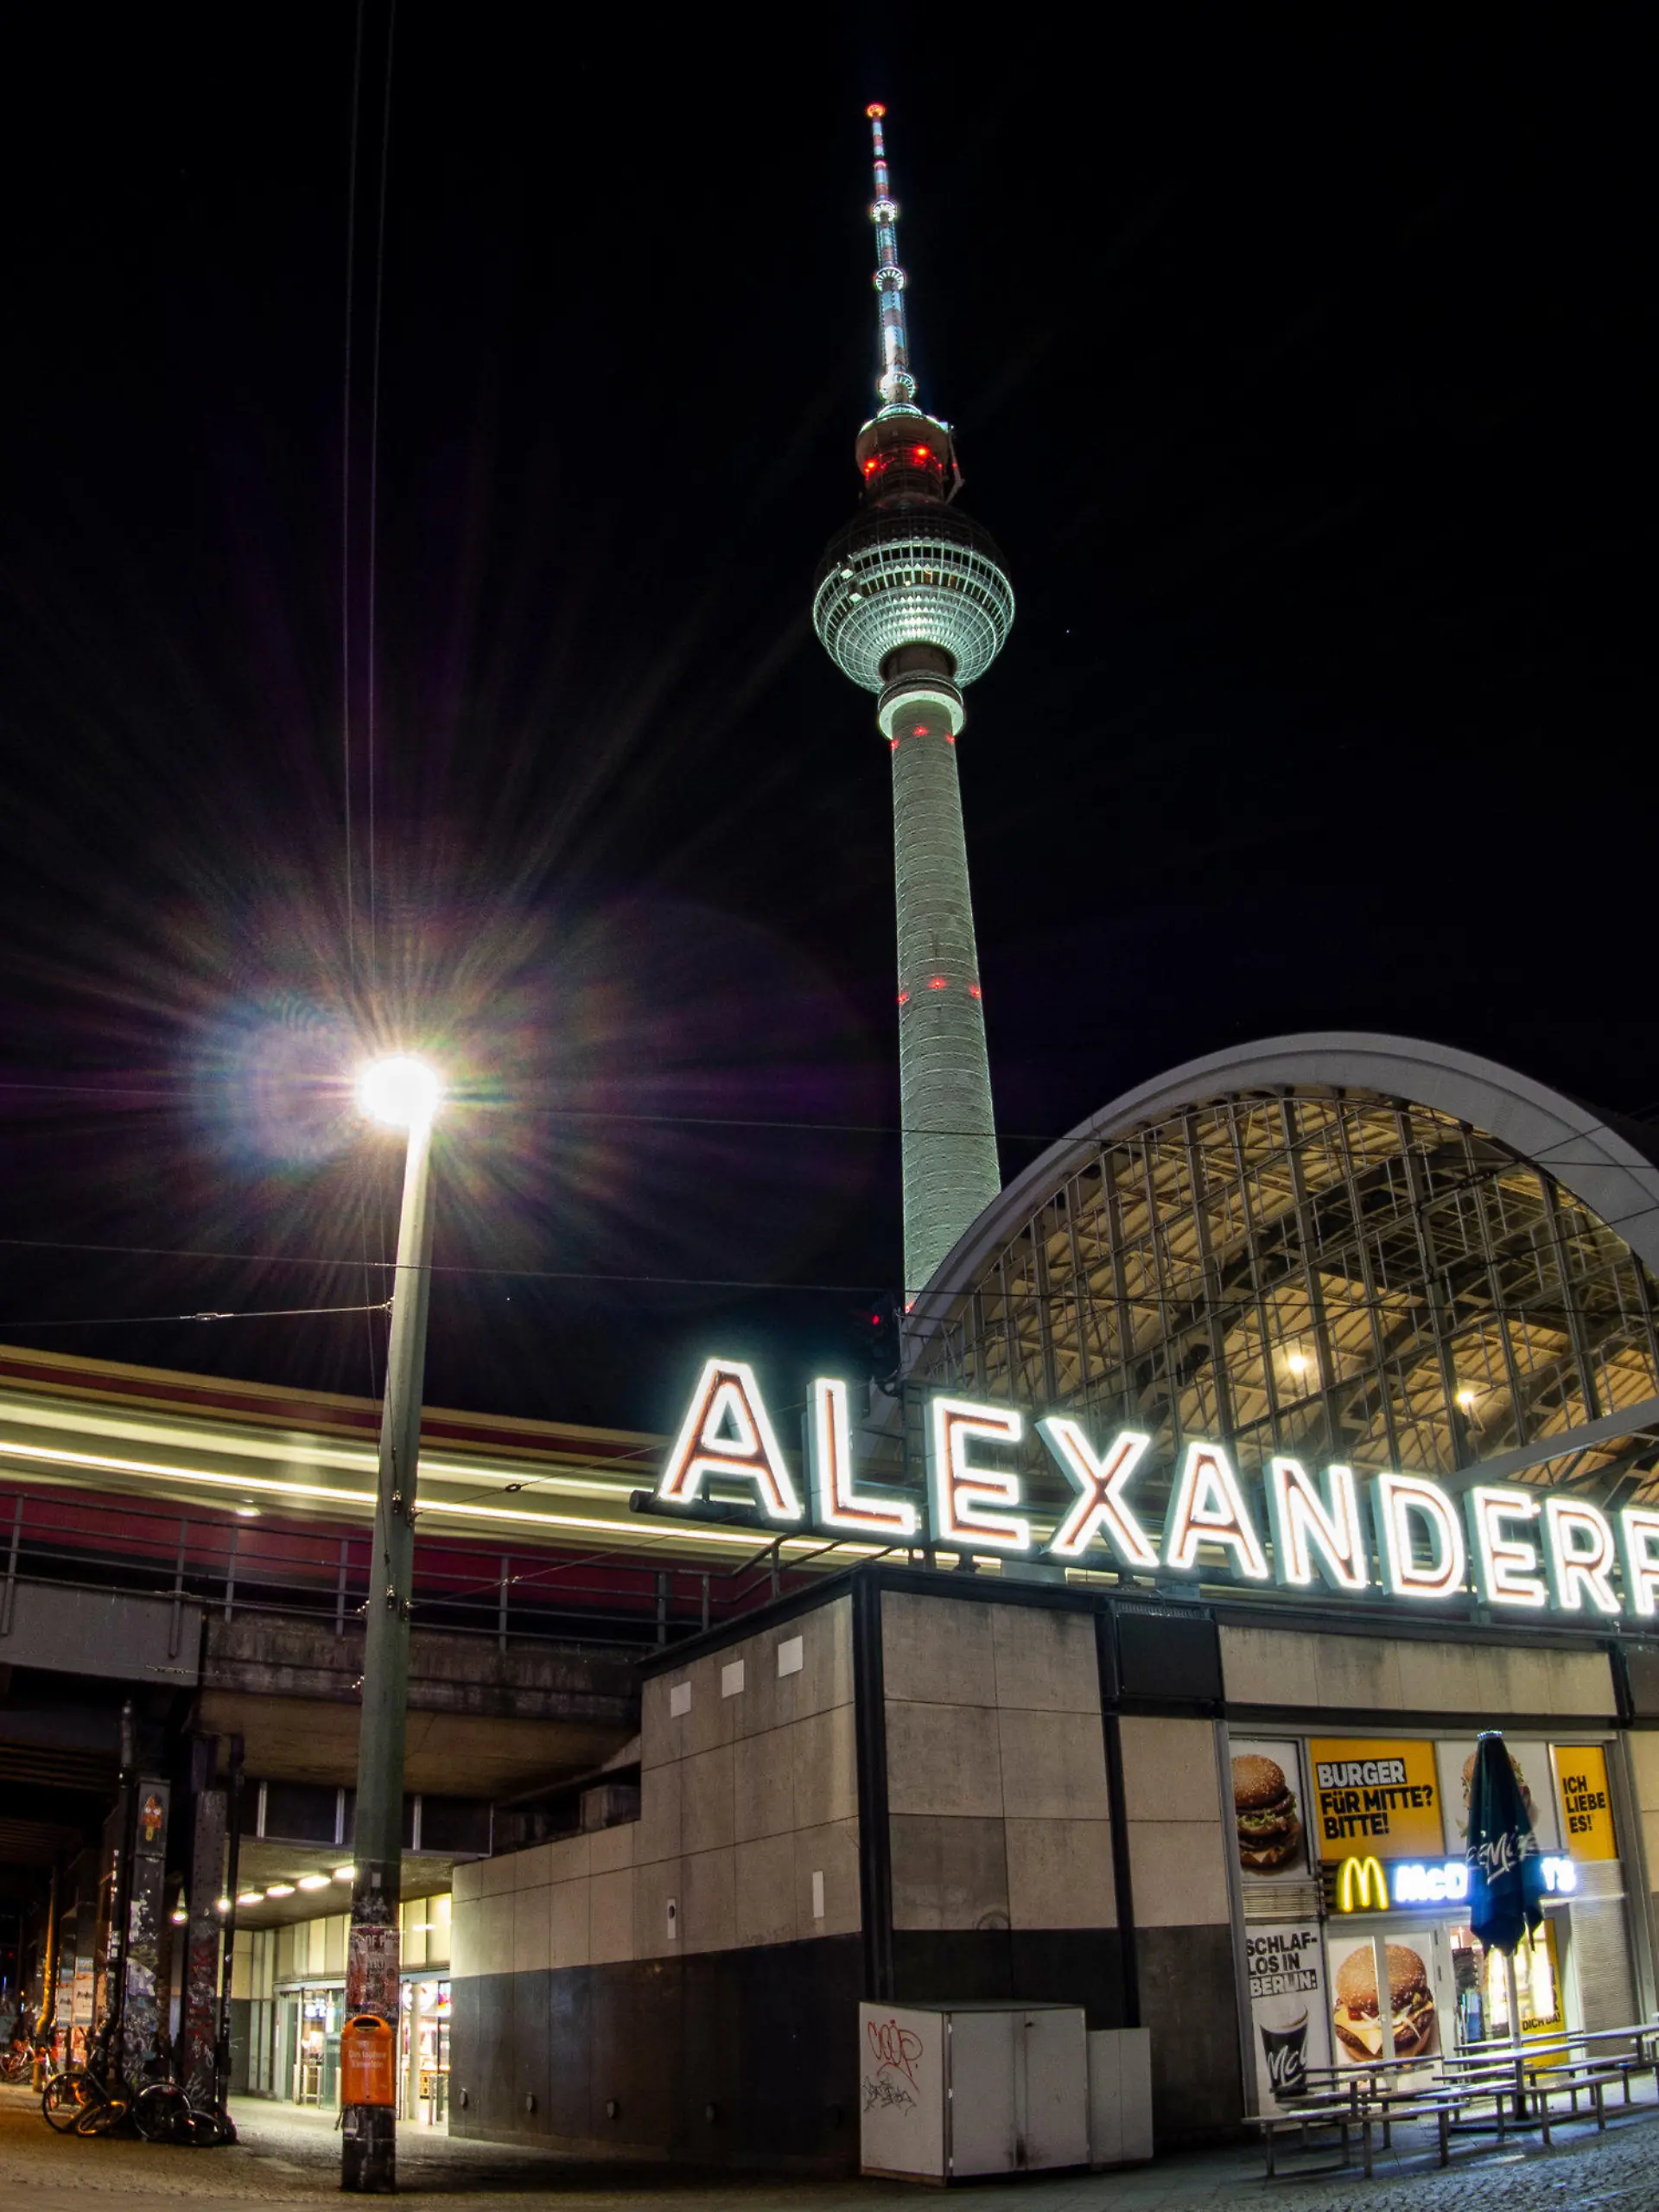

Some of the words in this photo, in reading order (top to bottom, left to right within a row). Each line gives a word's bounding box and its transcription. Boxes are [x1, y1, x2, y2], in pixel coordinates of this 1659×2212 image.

[1318, 1760, 1407, 1788] BURGER
[1562, 1776, 1588, 1795] ICH
[1363, 1785, 1433, 1812] MITTE?
[1566, 1792, 1606, 1814] LIEBE
[1324, 1813, 1389, 1840] BITTE!
[1569, 1815, 1593, 1834] ES!
[1246, 1932, 1318, 1955] SCHLAF-
[1248, 1955, 1280, 1975] LOS
[1282, 1953, 1300, 1971] IN
